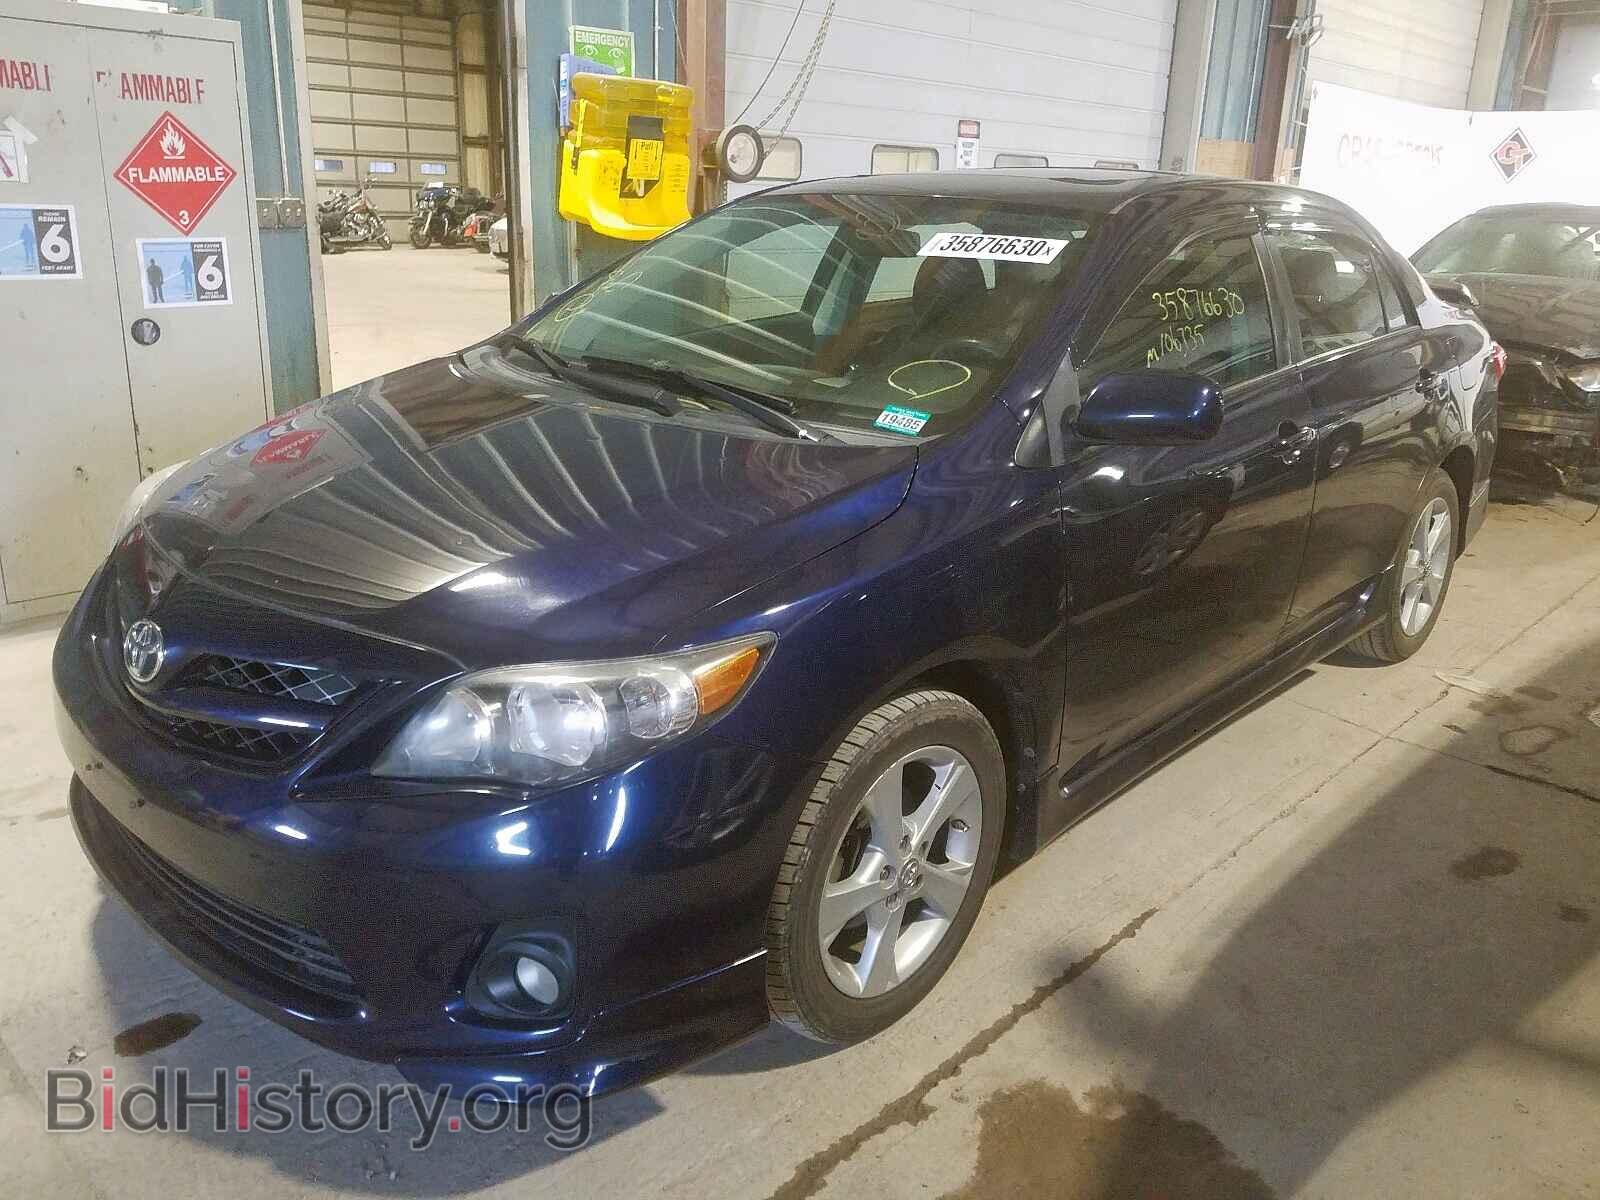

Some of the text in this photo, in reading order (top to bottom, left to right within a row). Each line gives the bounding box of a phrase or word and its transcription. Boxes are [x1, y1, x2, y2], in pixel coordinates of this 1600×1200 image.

[575, 31, 631, 48] EMERGENCY
[128, 166, 225, 183] FLAMMABLE
[179, 210, 190, 225] 3
[41, 224, 70, 263] 6
[940, 235, 1046, 257] 35876630
[198, 255, 223, 290] 6
[1152, 287, 1245, 321] 35876630
